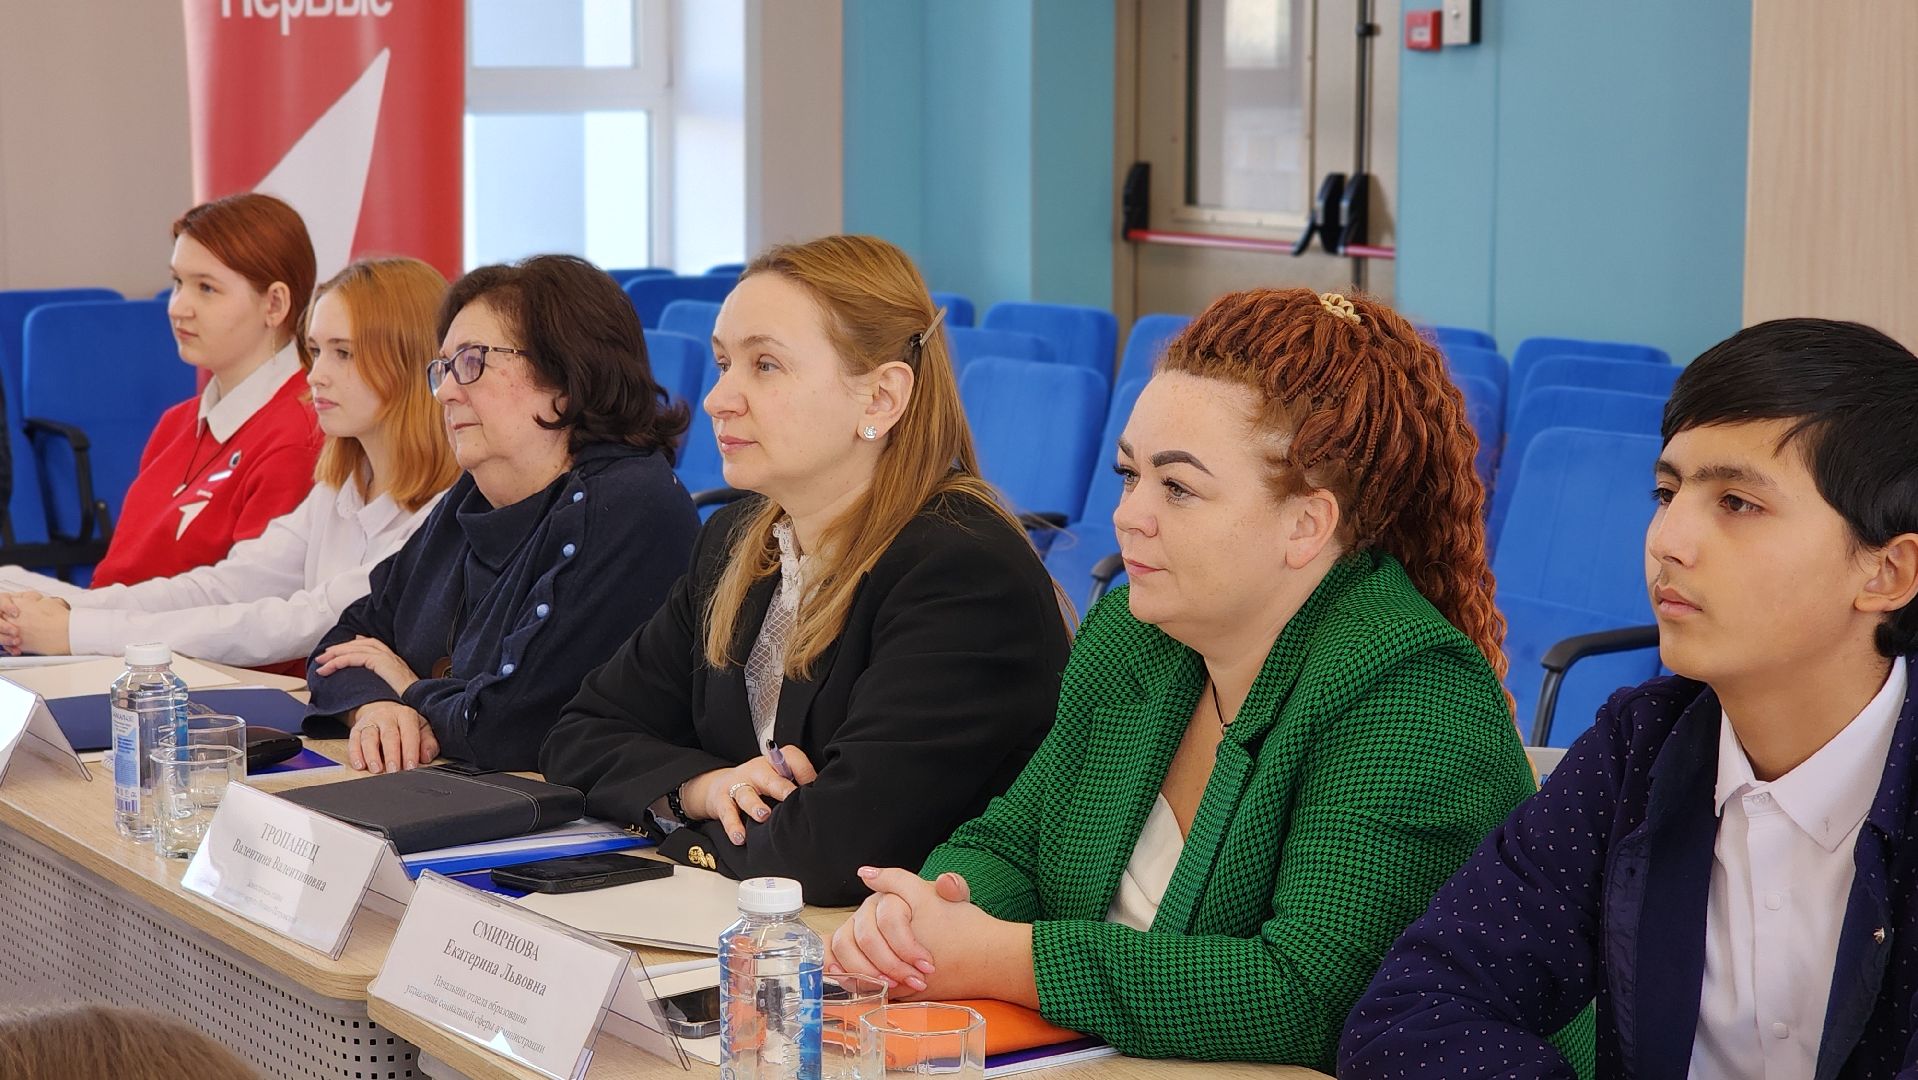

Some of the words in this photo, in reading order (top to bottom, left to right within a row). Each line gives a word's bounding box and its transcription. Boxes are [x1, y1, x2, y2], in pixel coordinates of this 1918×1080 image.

[232, 838, 273, 866] Валентина
[260, 822, 320, 864] ТРОПАНЕЦ
[472, 919, 540, 962] СМИРНОВА
[443, 938, 500, 975] Екатерина
[499, 963, 547, 996] Львовна
